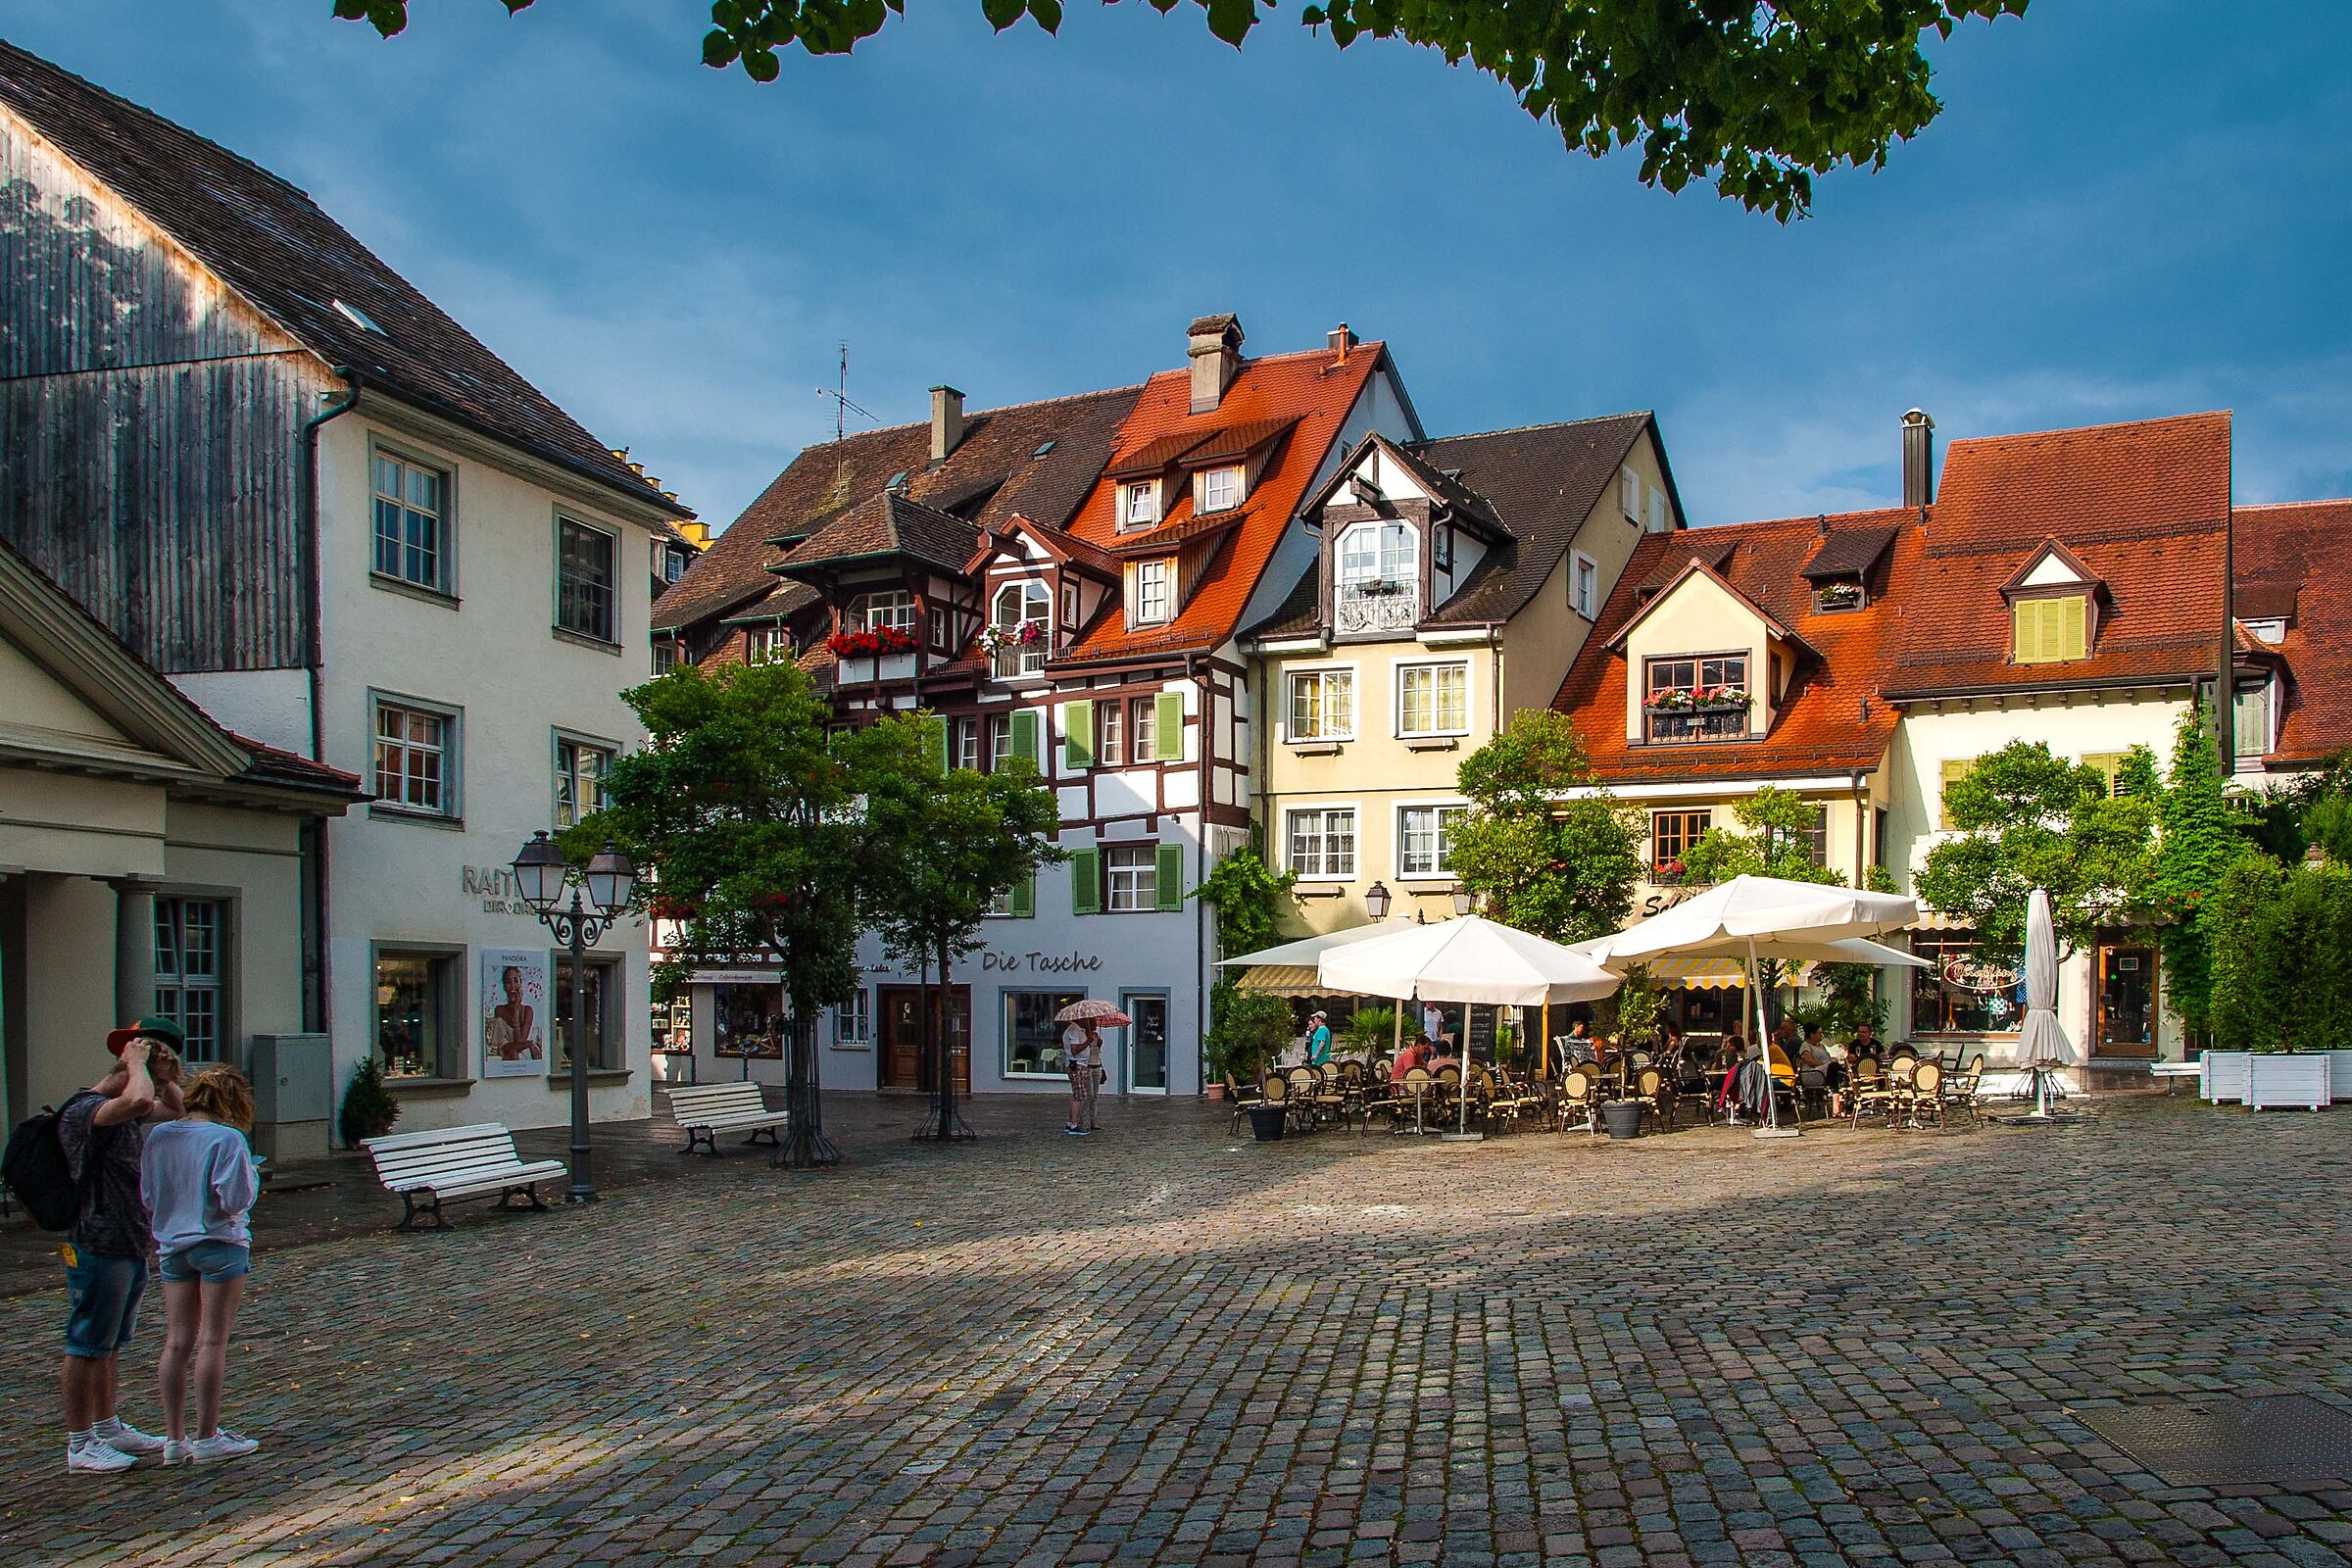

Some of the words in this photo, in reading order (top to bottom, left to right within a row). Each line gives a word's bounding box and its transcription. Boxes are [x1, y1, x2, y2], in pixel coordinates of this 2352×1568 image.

[463, 864, 520, 898] RAIT
[982, 951, 1020, 971] Die
[1025, 950, 1103, 973] Tasche
